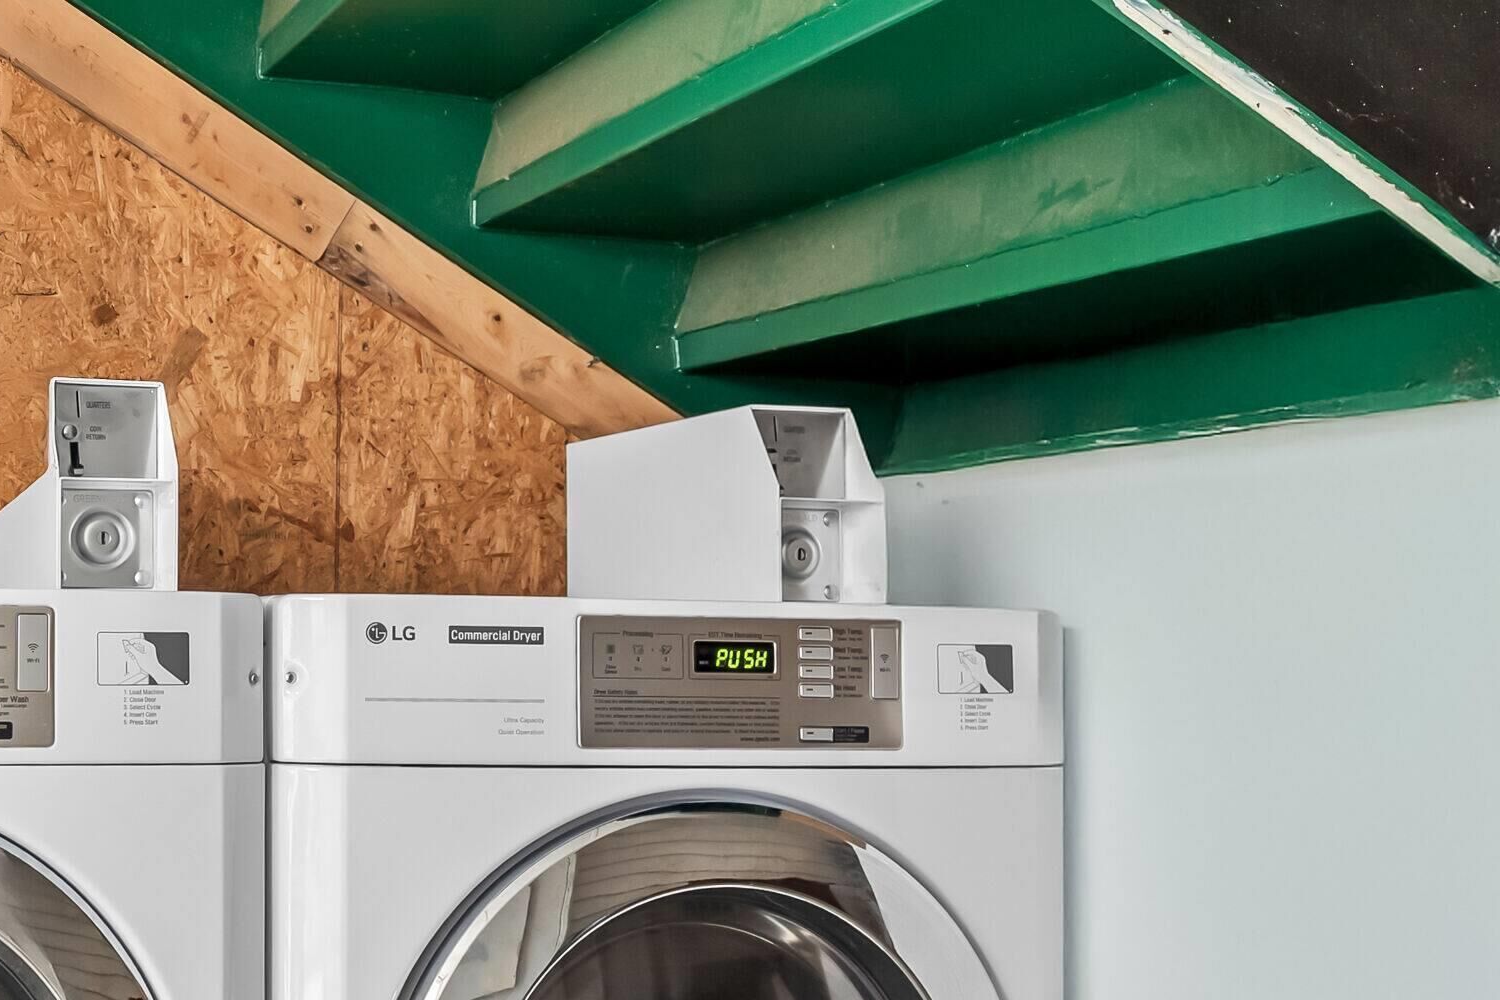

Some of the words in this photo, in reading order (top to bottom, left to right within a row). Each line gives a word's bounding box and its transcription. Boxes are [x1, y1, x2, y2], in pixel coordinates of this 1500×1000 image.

[86, 401, 111, 409] QUARTERS
[392, 626, 416, 640] LG
[451, 630, 511, 641] Commercial
[513, 630, 542, 643] Dryer
[715, 648, 768, 669] PUSH
